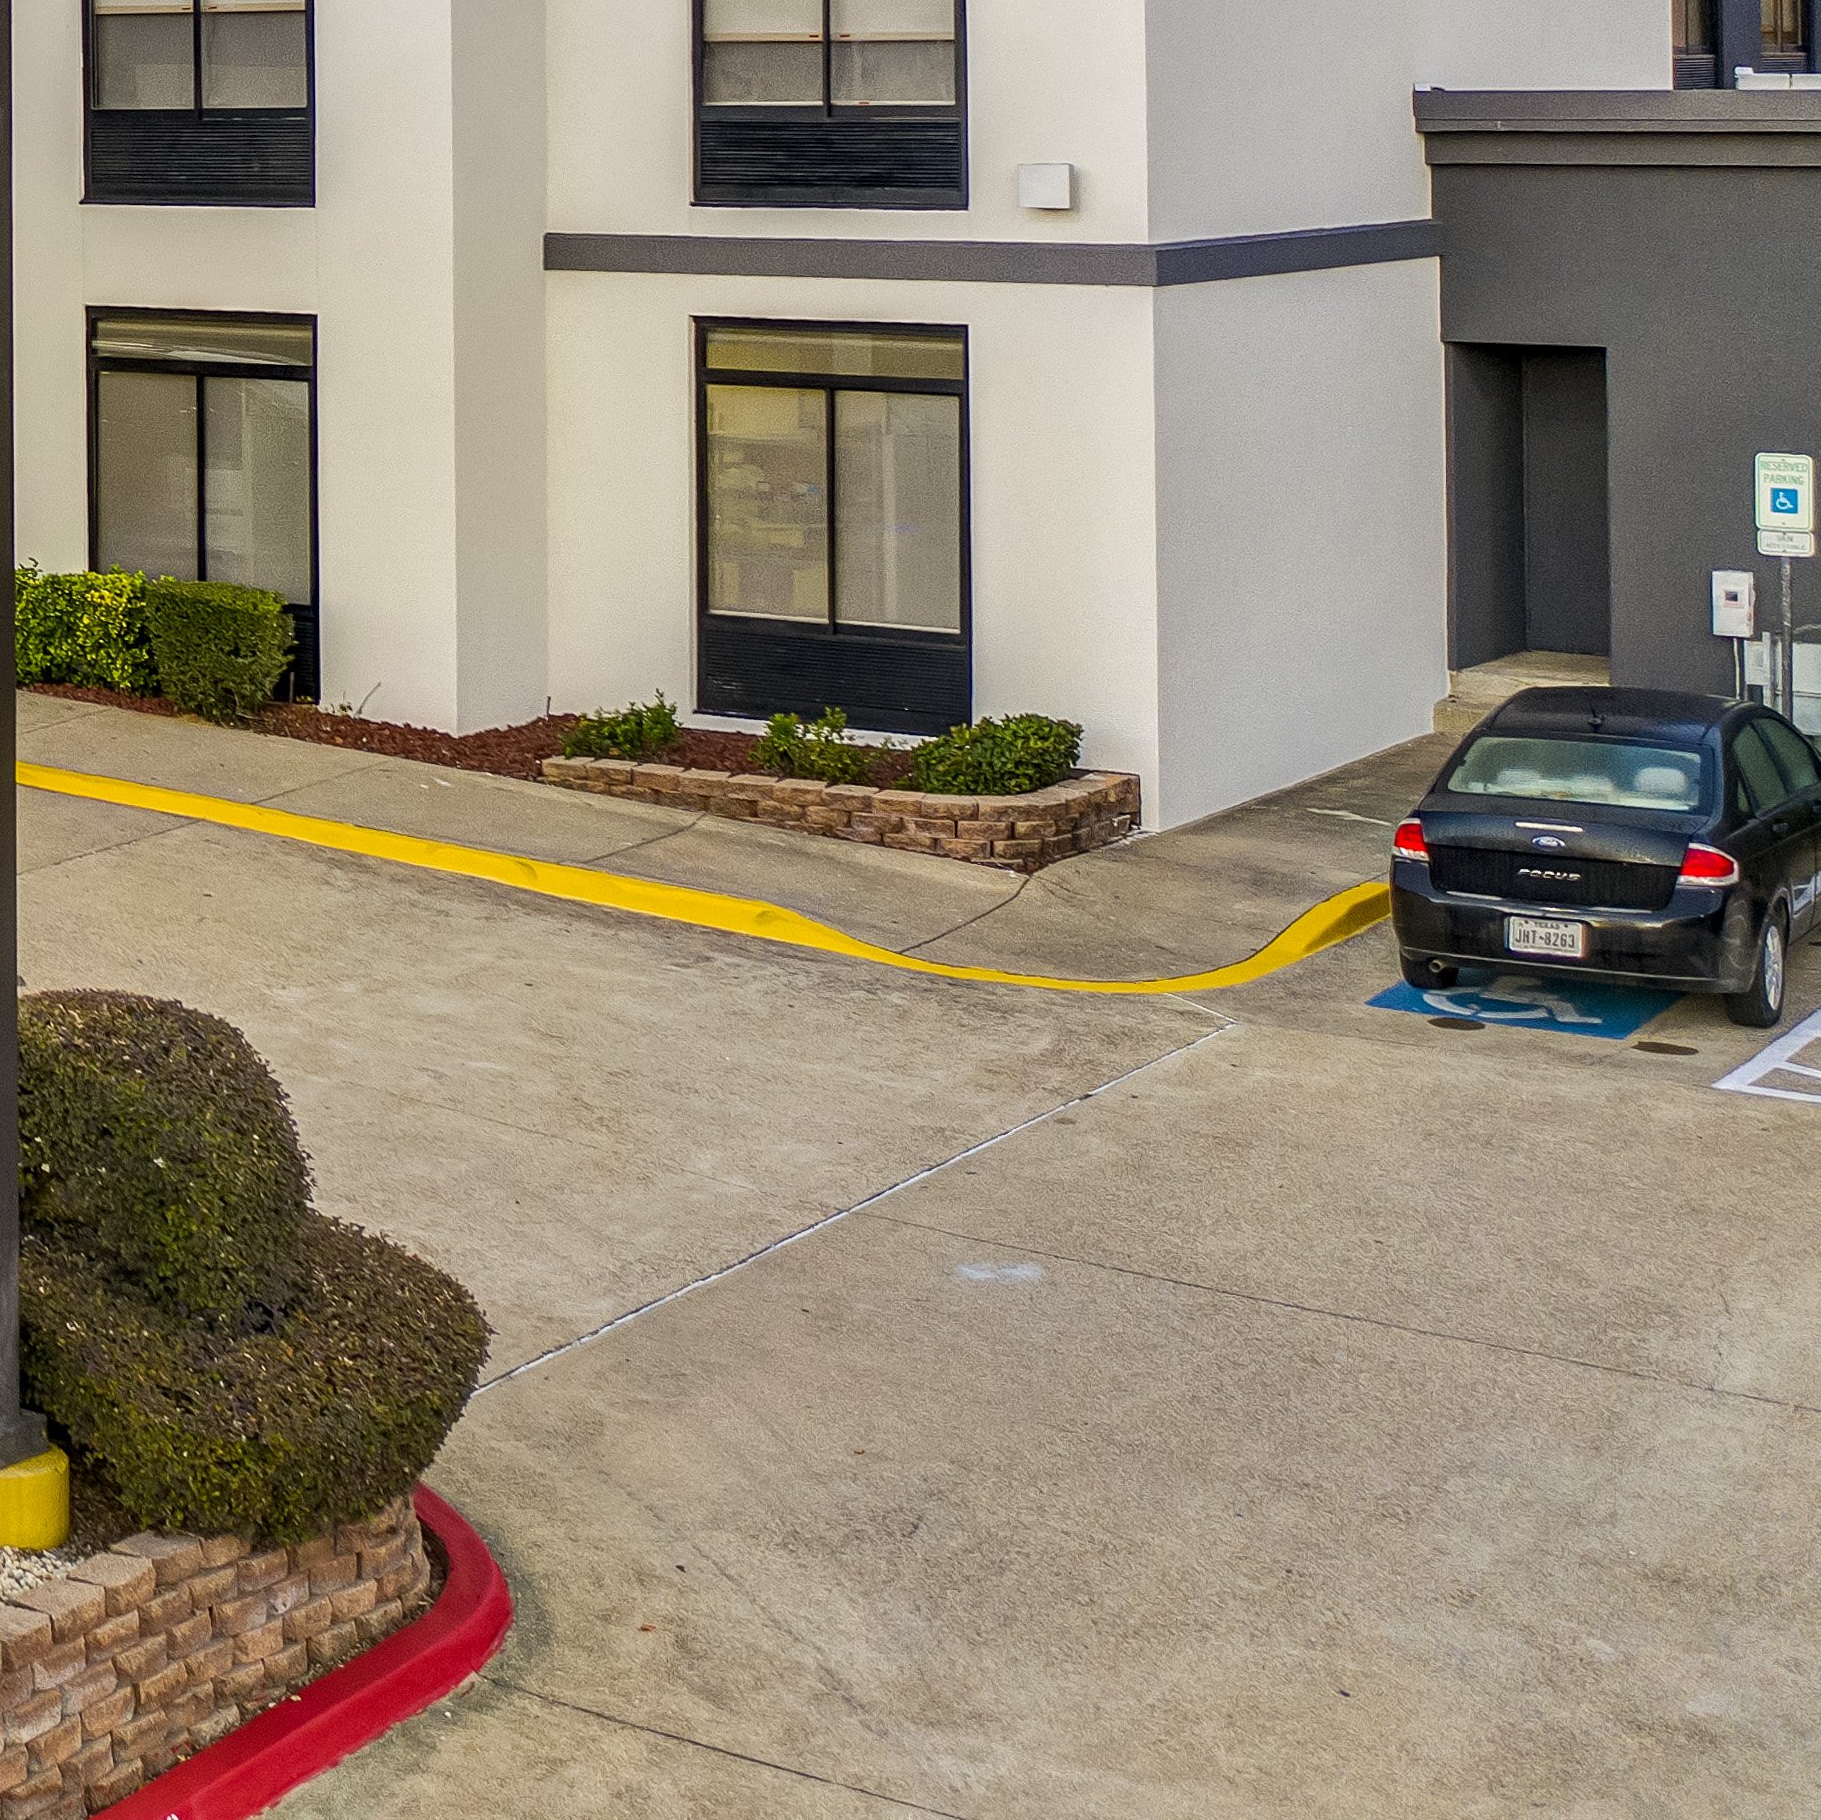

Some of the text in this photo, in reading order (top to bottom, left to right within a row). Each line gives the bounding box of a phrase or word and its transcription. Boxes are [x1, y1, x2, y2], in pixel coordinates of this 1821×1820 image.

[1760, 460, 1809, 473] RESERVED
[1763, 473, 1805, 485] PARKING
[1517, 868, 1583, 882] FOCUS
[1533, 921, 1560, 930] TEXAS
